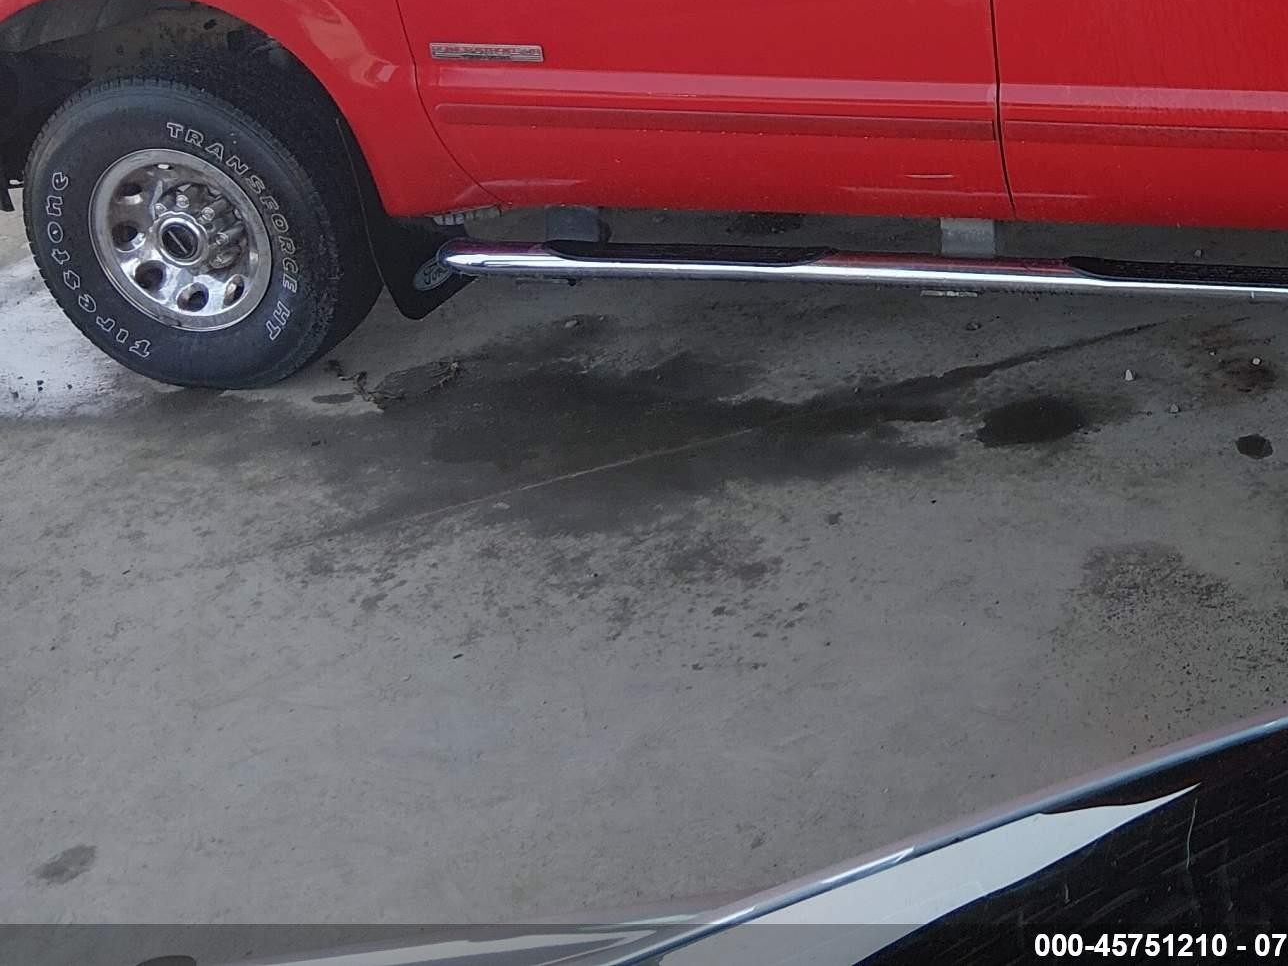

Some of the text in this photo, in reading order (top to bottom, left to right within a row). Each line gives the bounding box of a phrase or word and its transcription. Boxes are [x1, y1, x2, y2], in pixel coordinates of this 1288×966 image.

[45, 171, 152, 358] Firestone
[166, 122, 299, 341] TRANSFORCE HT
